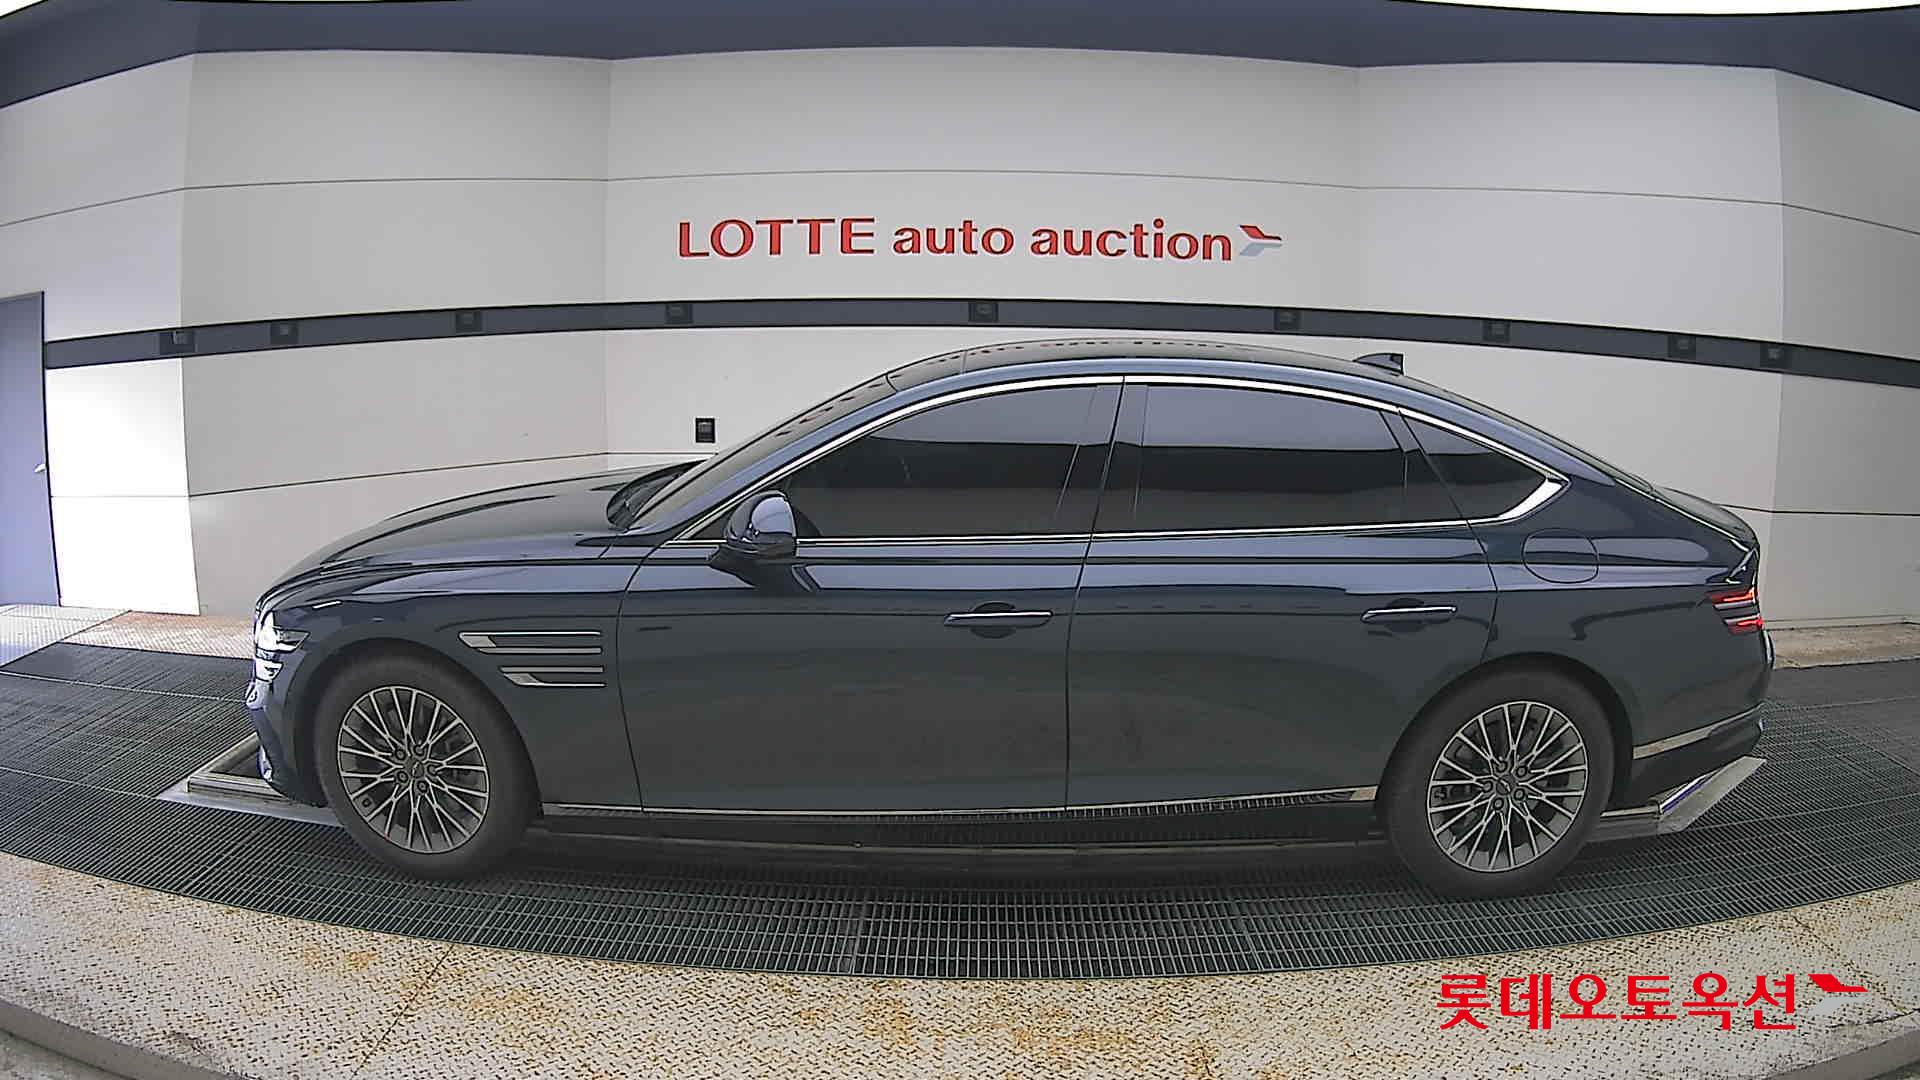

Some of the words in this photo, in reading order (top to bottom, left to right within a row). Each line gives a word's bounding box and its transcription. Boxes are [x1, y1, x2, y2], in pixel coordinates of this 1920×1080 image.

[679, 217, 875, 258] LOTTE
[893, 220, 1015, 255] auto
[1030, 218, 1232, 261] auction
